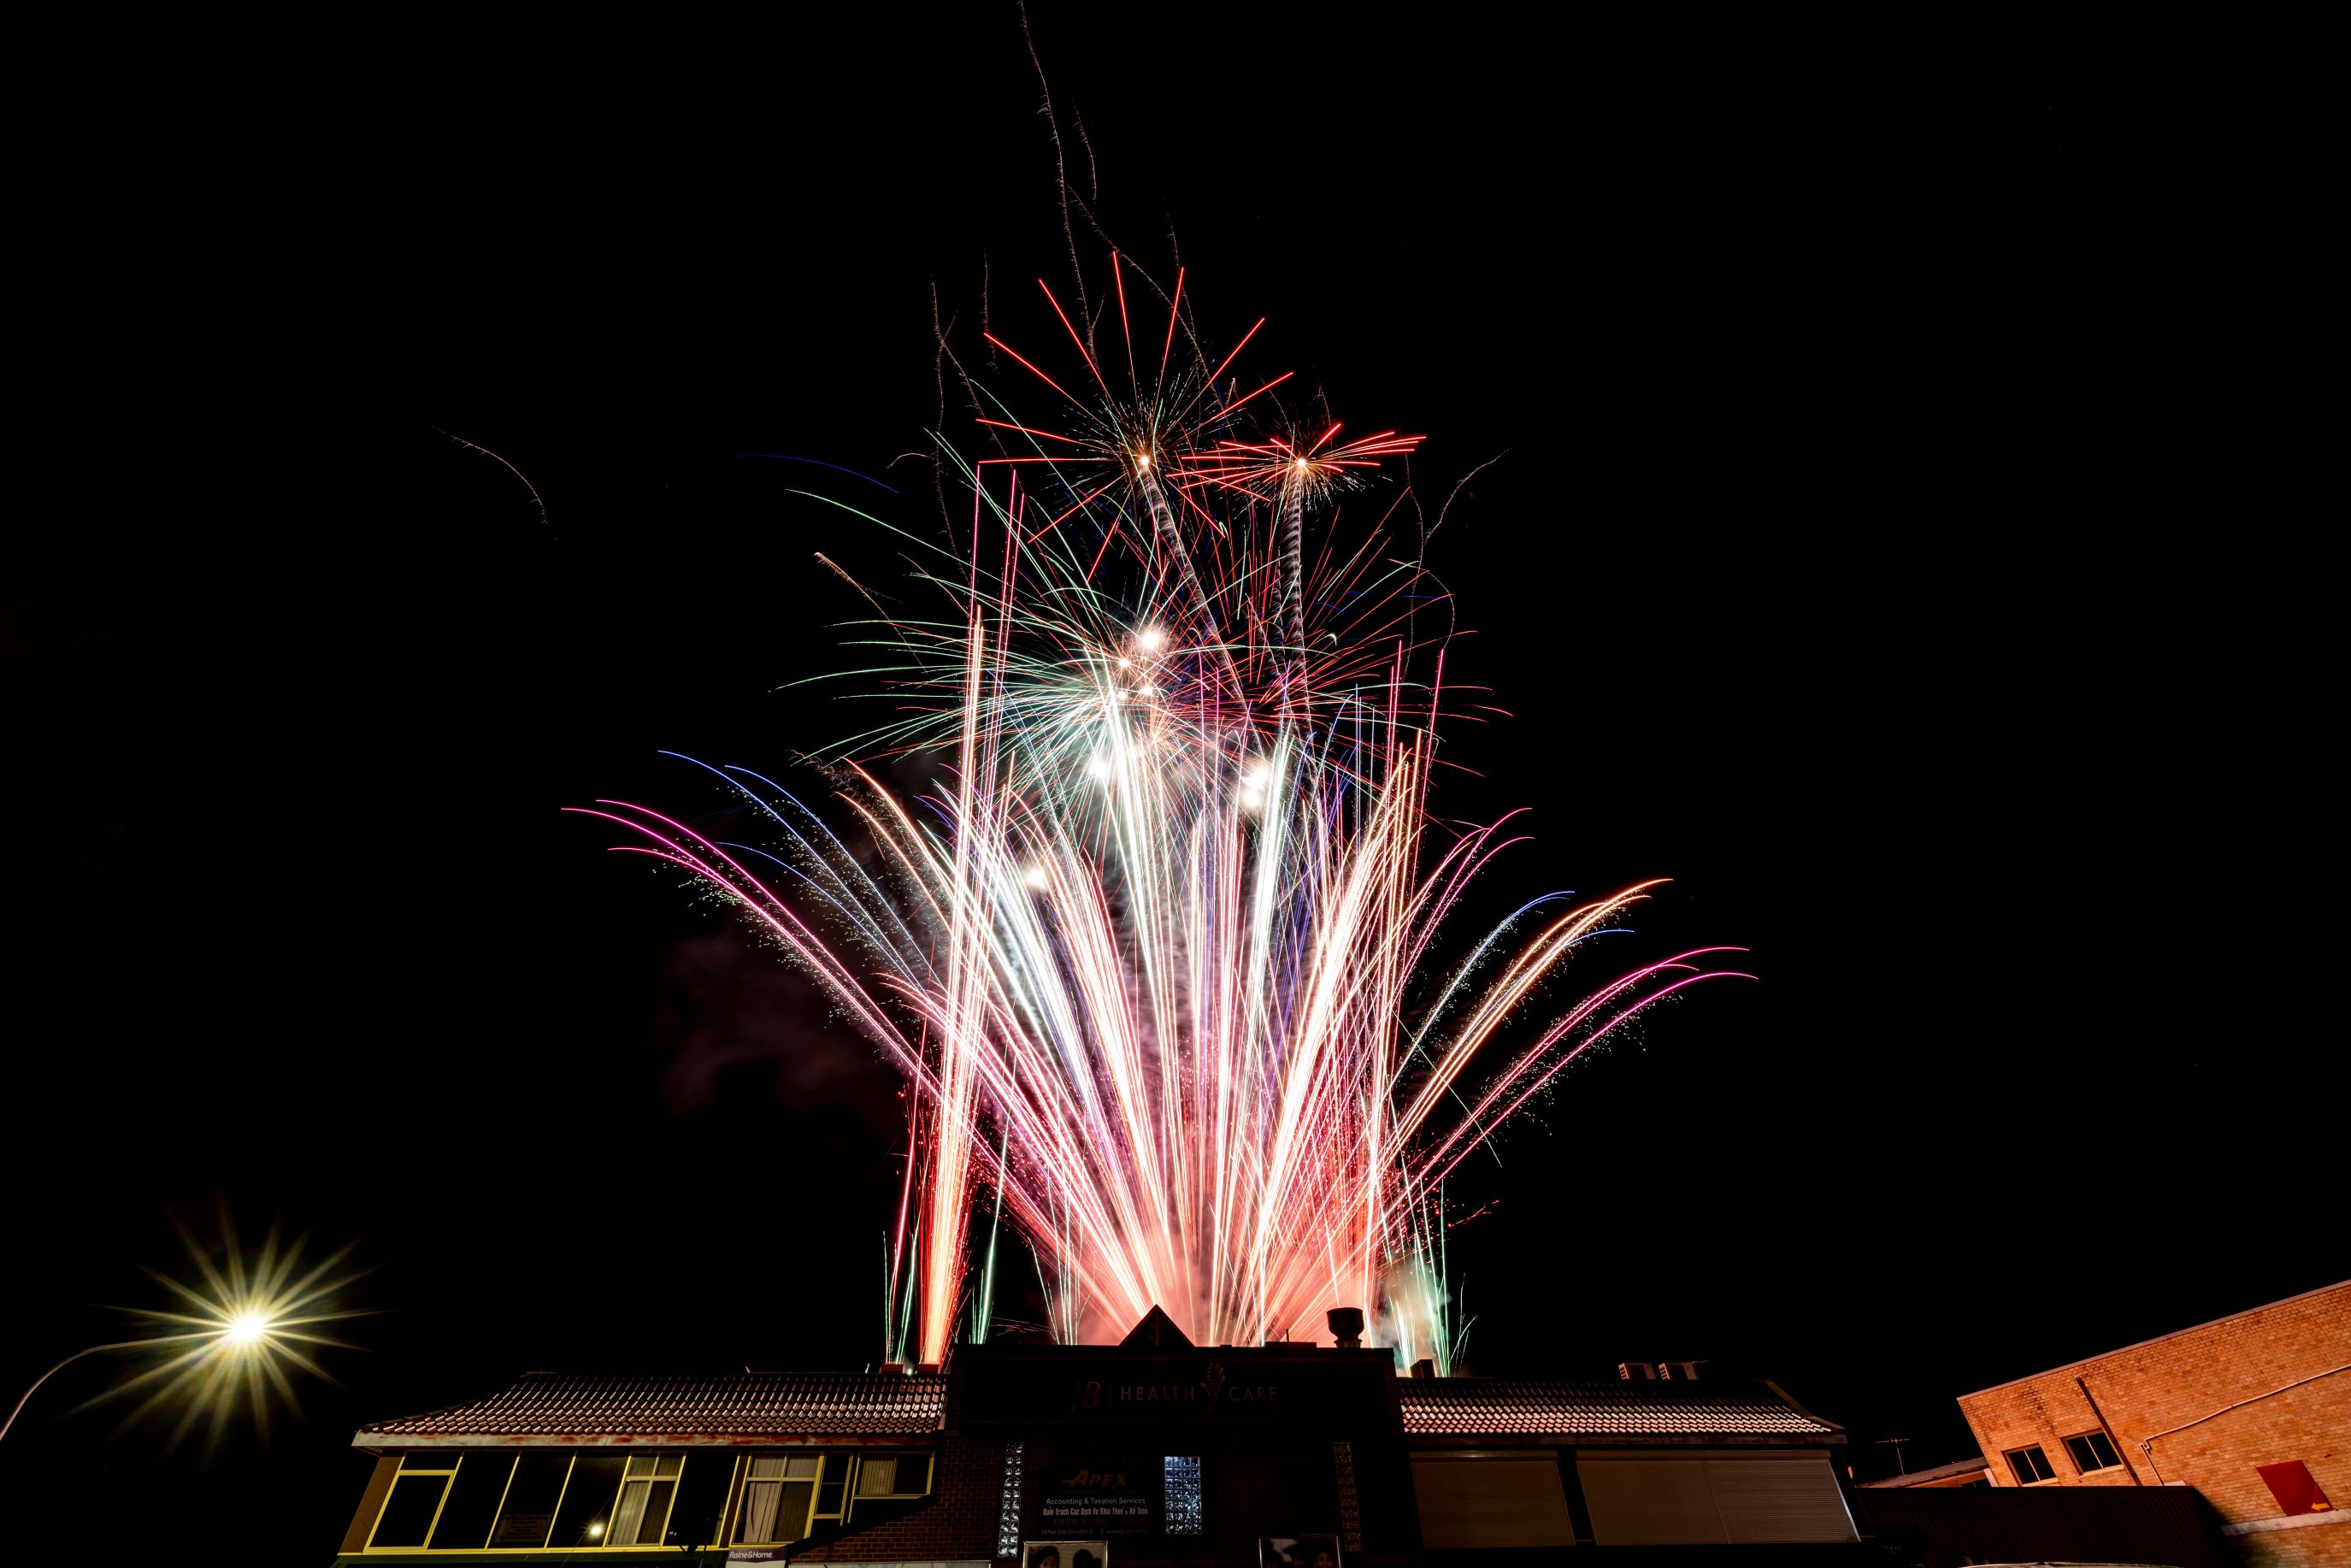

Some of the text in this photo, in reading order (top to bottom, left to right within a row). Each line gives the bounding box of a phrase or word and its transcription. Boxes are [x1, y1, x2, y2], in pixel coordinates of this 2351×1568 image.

[1120, 1386, 1195, 1402] HEALTH
[1229, 1386, 1277, 1402] CARE
[1062, 1470, 1131, 1489] APEX
[1046, 1497, 1082, 1506] Accounting
